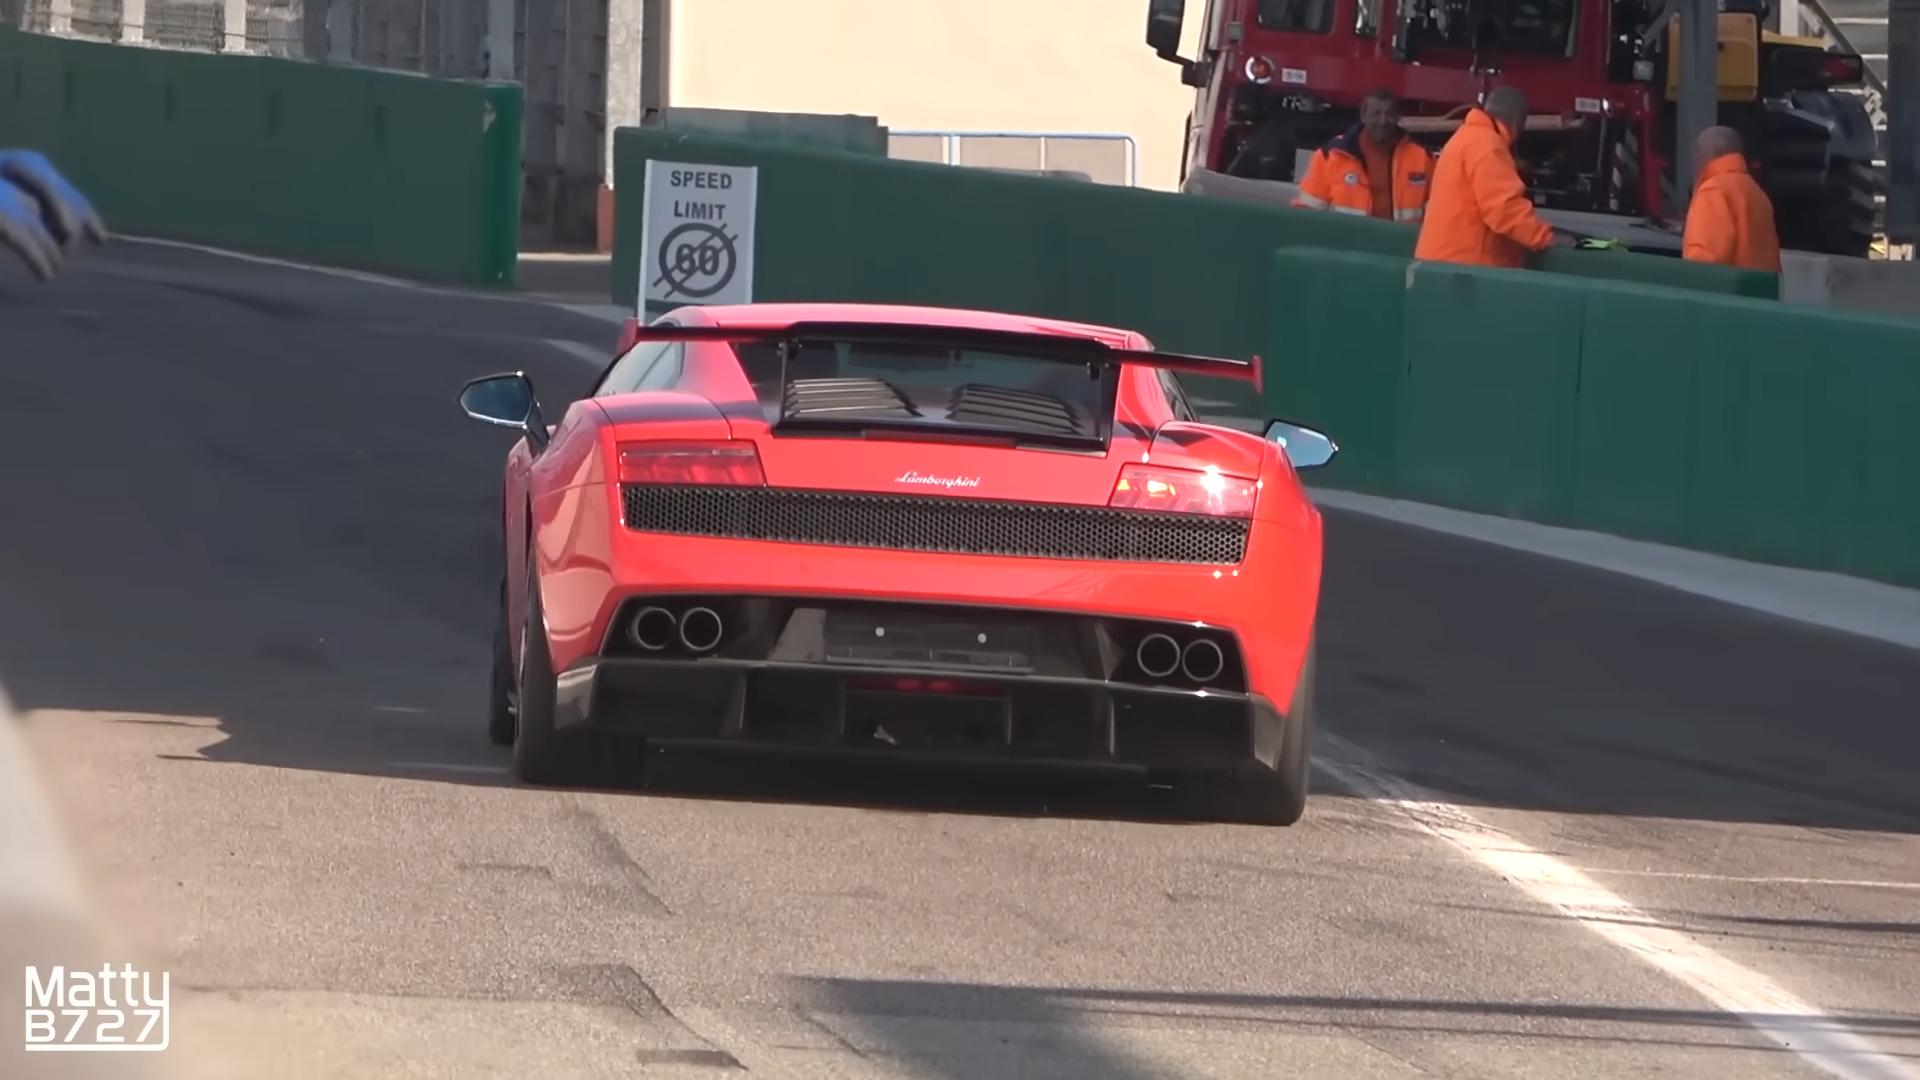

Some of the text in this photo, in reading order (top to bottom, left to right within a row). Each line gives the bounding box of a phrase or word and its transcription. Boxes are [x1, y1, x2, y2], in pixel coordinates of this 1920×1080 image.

[670, 170, 732, 189] SPEED
[673, 200, 726, 220] LIMIT
[676, 243, 719, 276] 60
[894, 471, 981, 489] Lamborghini
